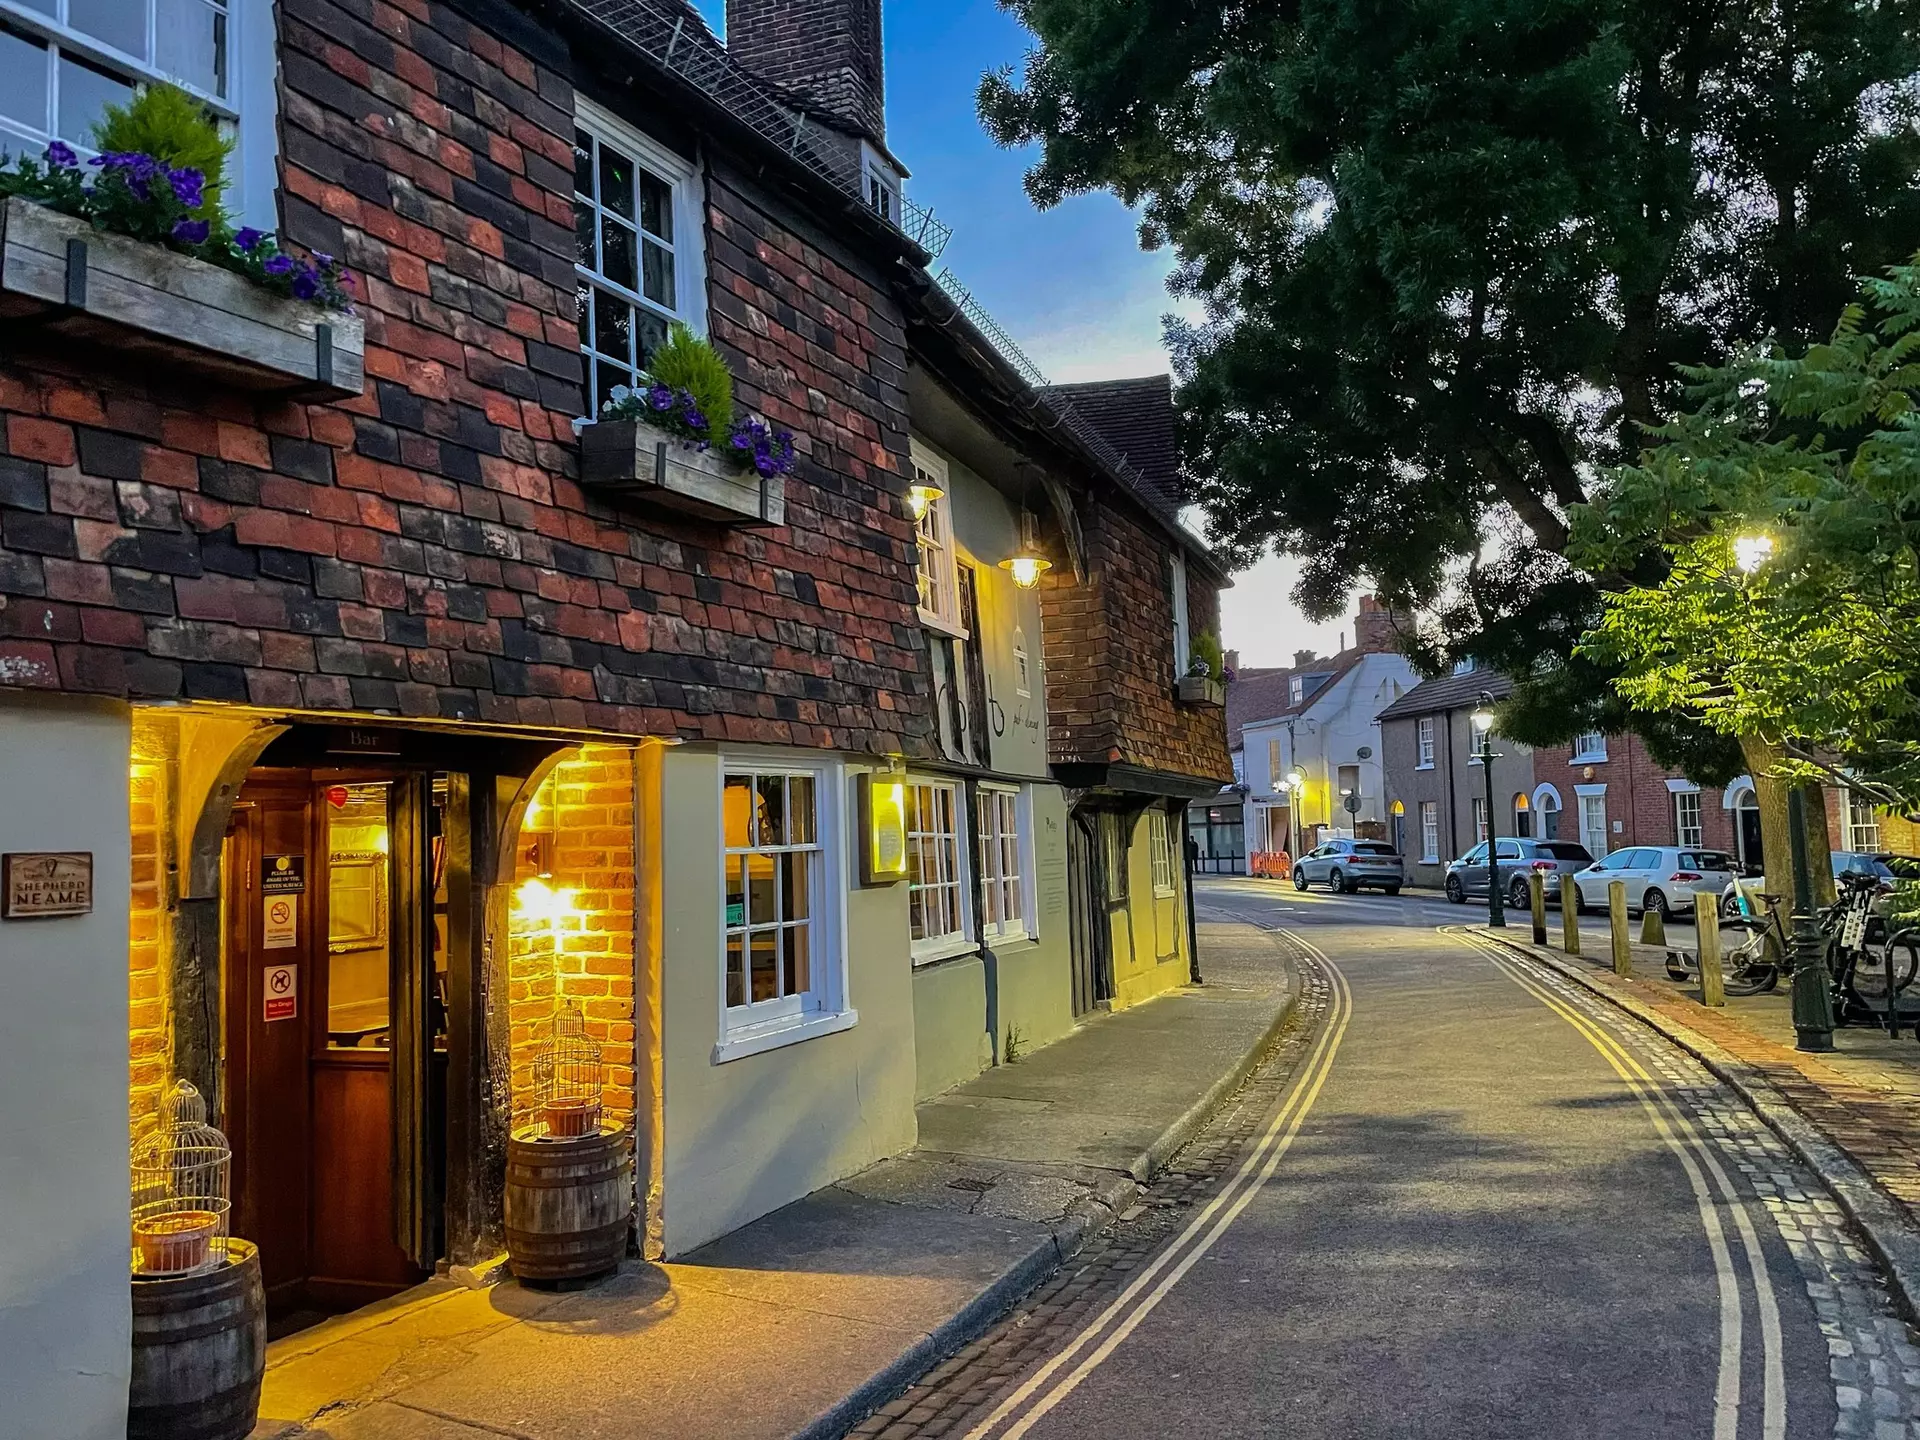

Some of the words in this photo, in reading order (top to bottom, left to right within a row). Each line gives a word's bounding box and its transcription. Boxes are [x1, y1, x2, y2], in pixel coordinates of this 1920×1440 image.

[350, 730, 380, 746] Bar
[16, 881, 85, 892] SHEPHERD
[16, 890, 85, 906] NEAME
